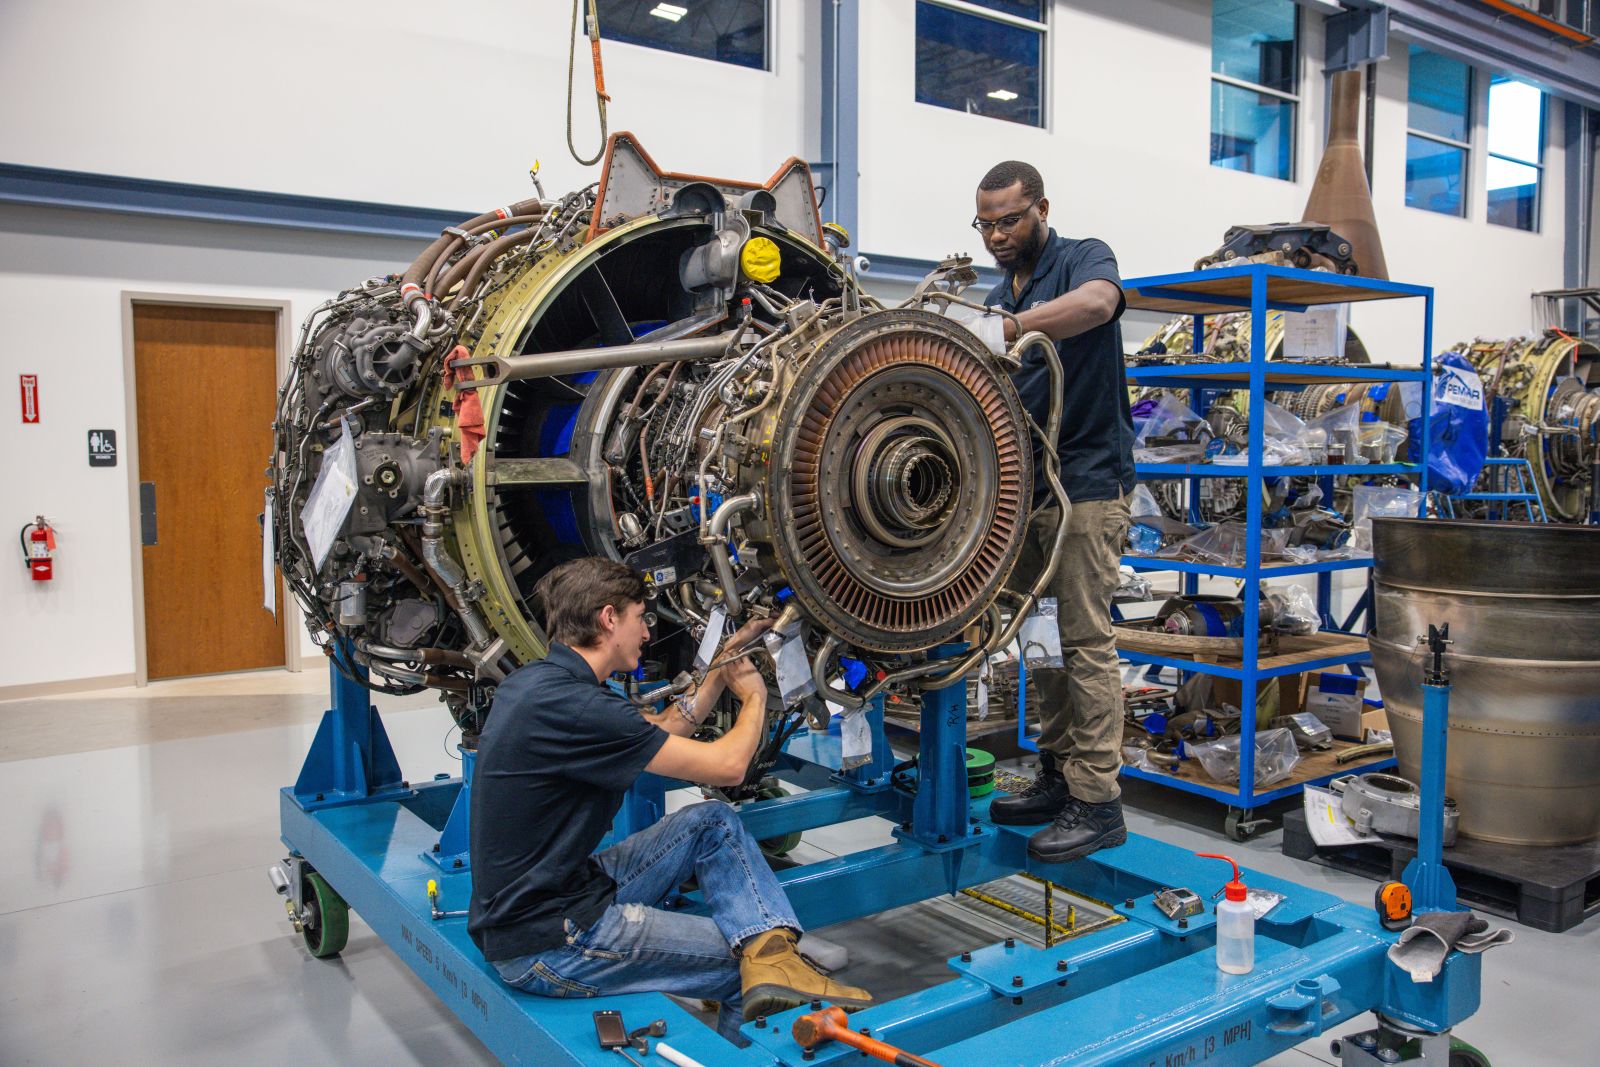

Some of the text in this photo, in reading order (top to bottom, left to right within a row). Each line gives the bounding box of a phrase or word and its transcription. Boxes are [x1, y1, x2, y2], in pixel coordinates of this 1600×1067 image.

[1447, 383, 1480, 400] PEMAR
[415, 938, 433, 965] SPEED
[1165, 1020, 1252, 1067] Km/h [3 MPH]
